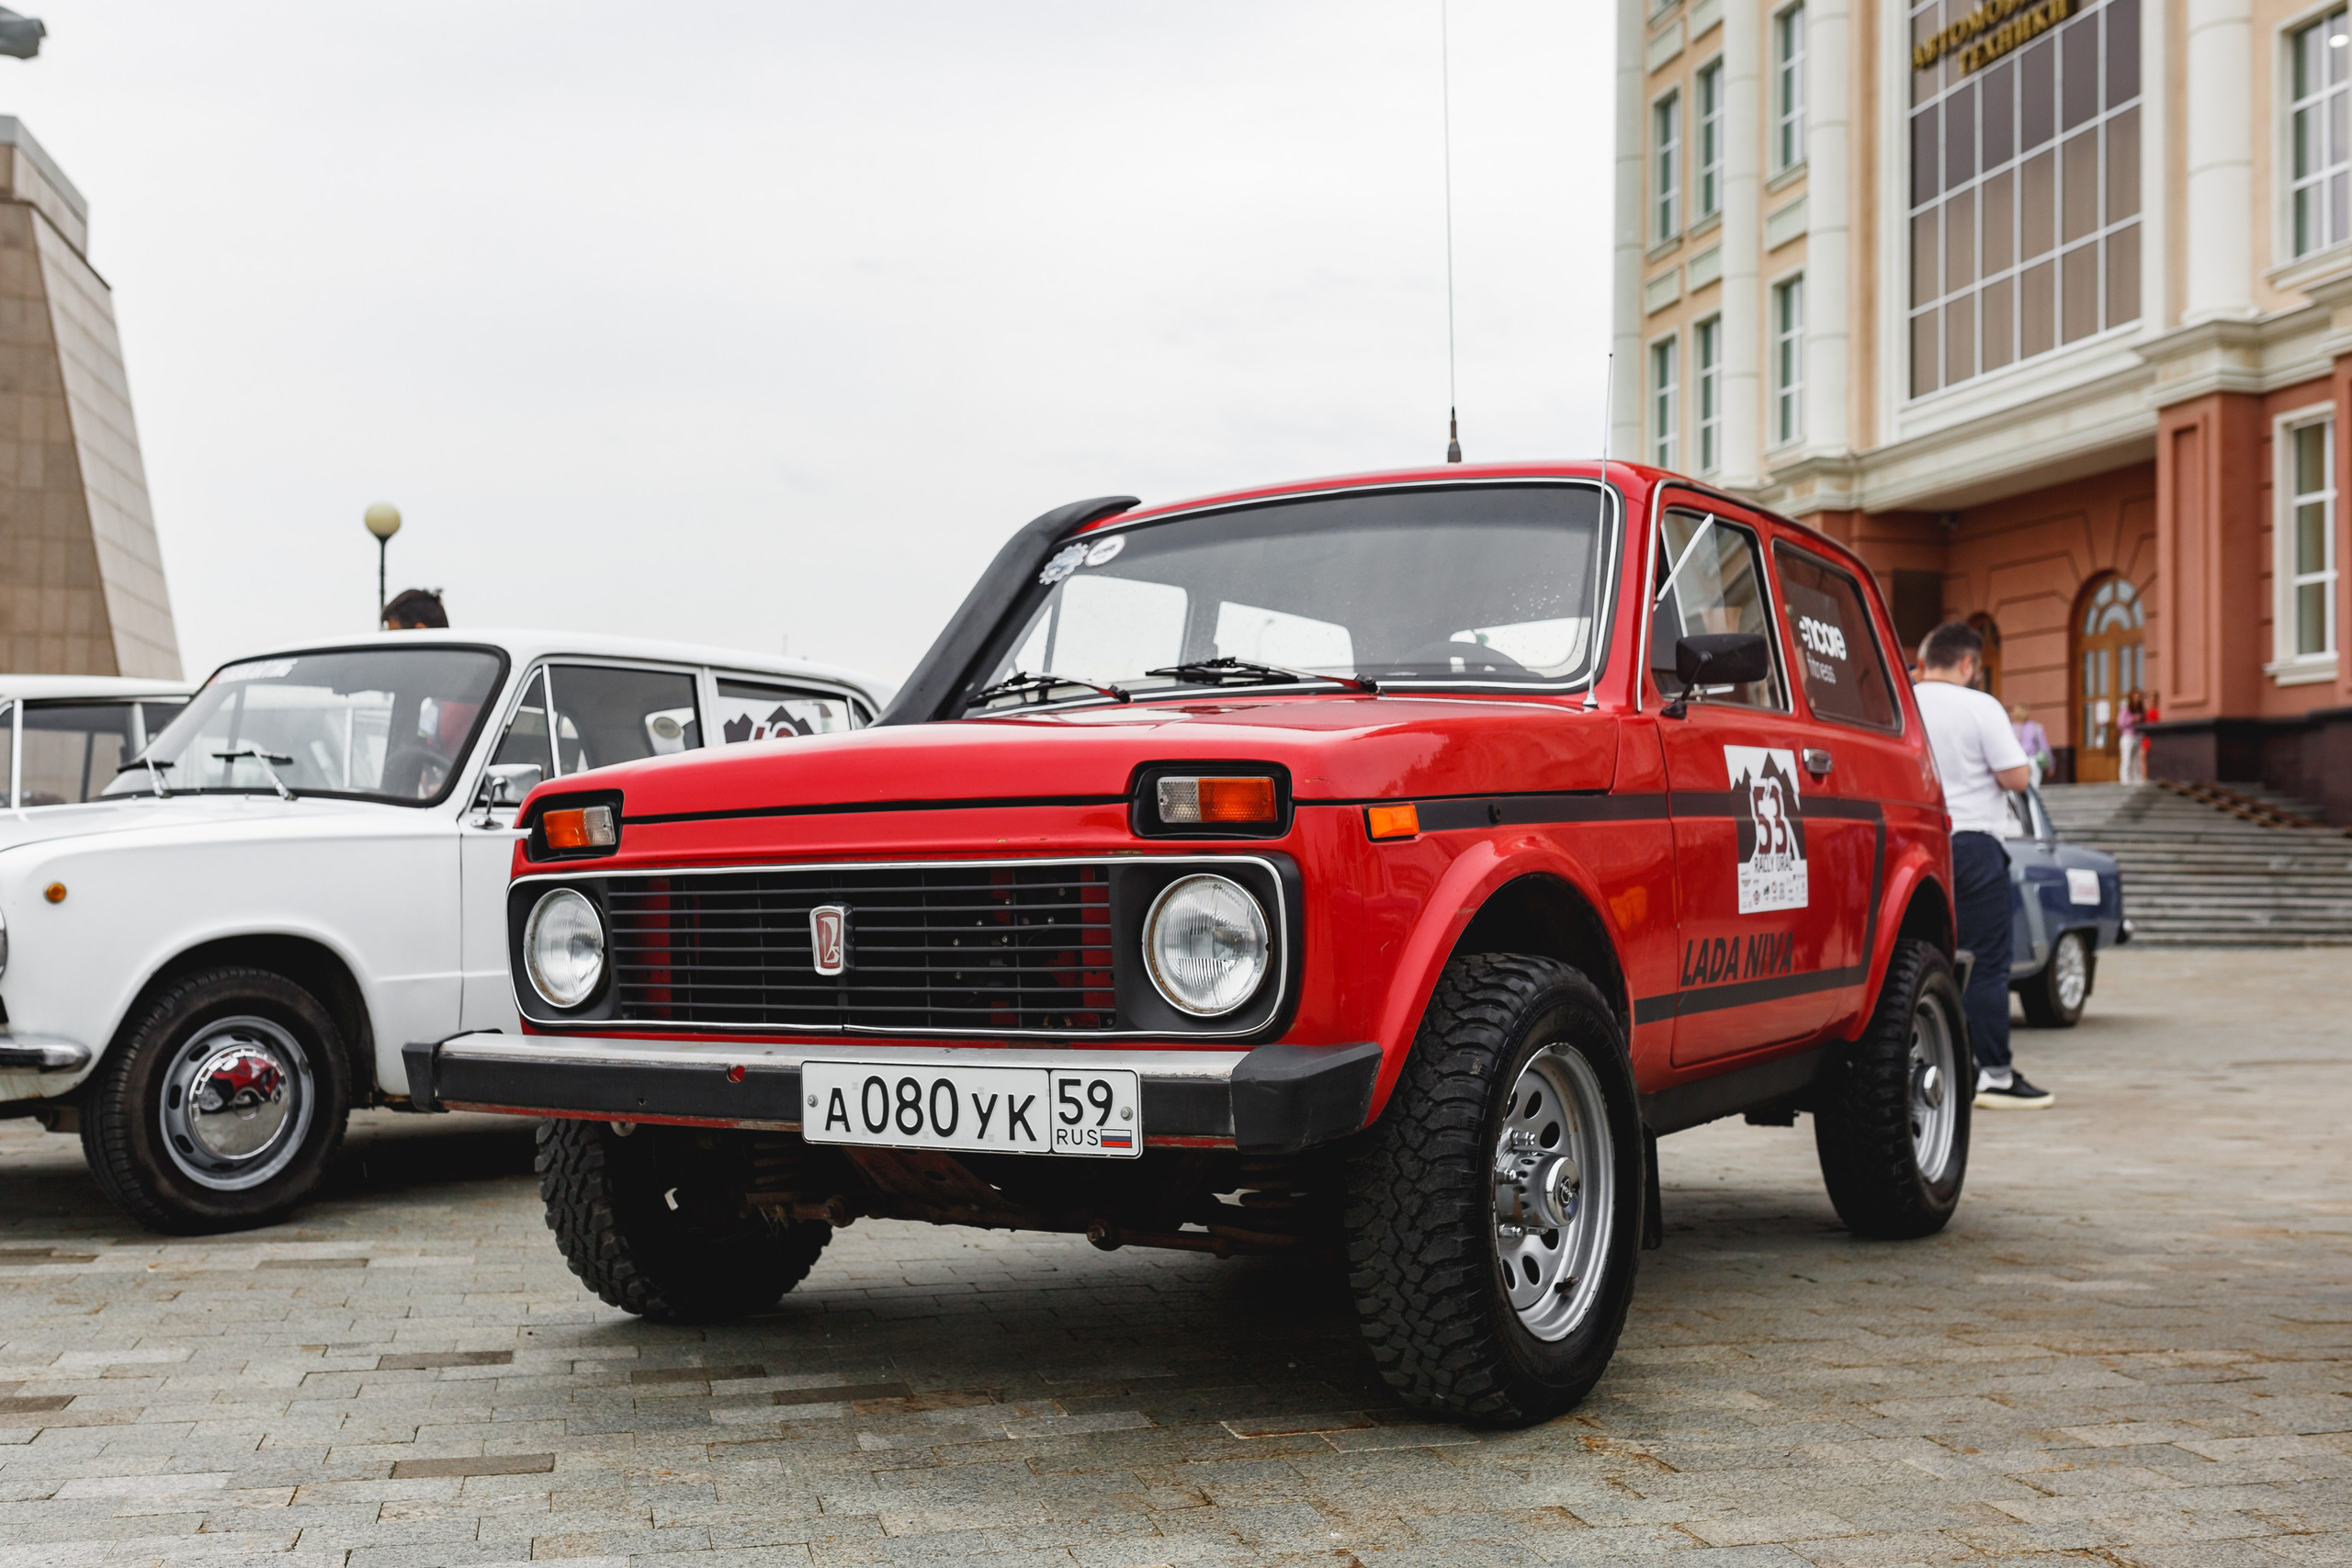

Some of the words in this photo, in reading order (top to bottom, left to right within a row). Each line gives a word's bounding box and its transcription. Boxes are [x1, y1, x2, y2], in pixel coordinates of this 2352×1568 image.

[1751, 782, 1788, 855] 53
[1680, 935, 1740, 987] LADA
[1743, 931, 1793, 979] NIVA
[1058, 1077, 1114, 1126] 59
[1057, 1128, 1099, 1146] RUS
